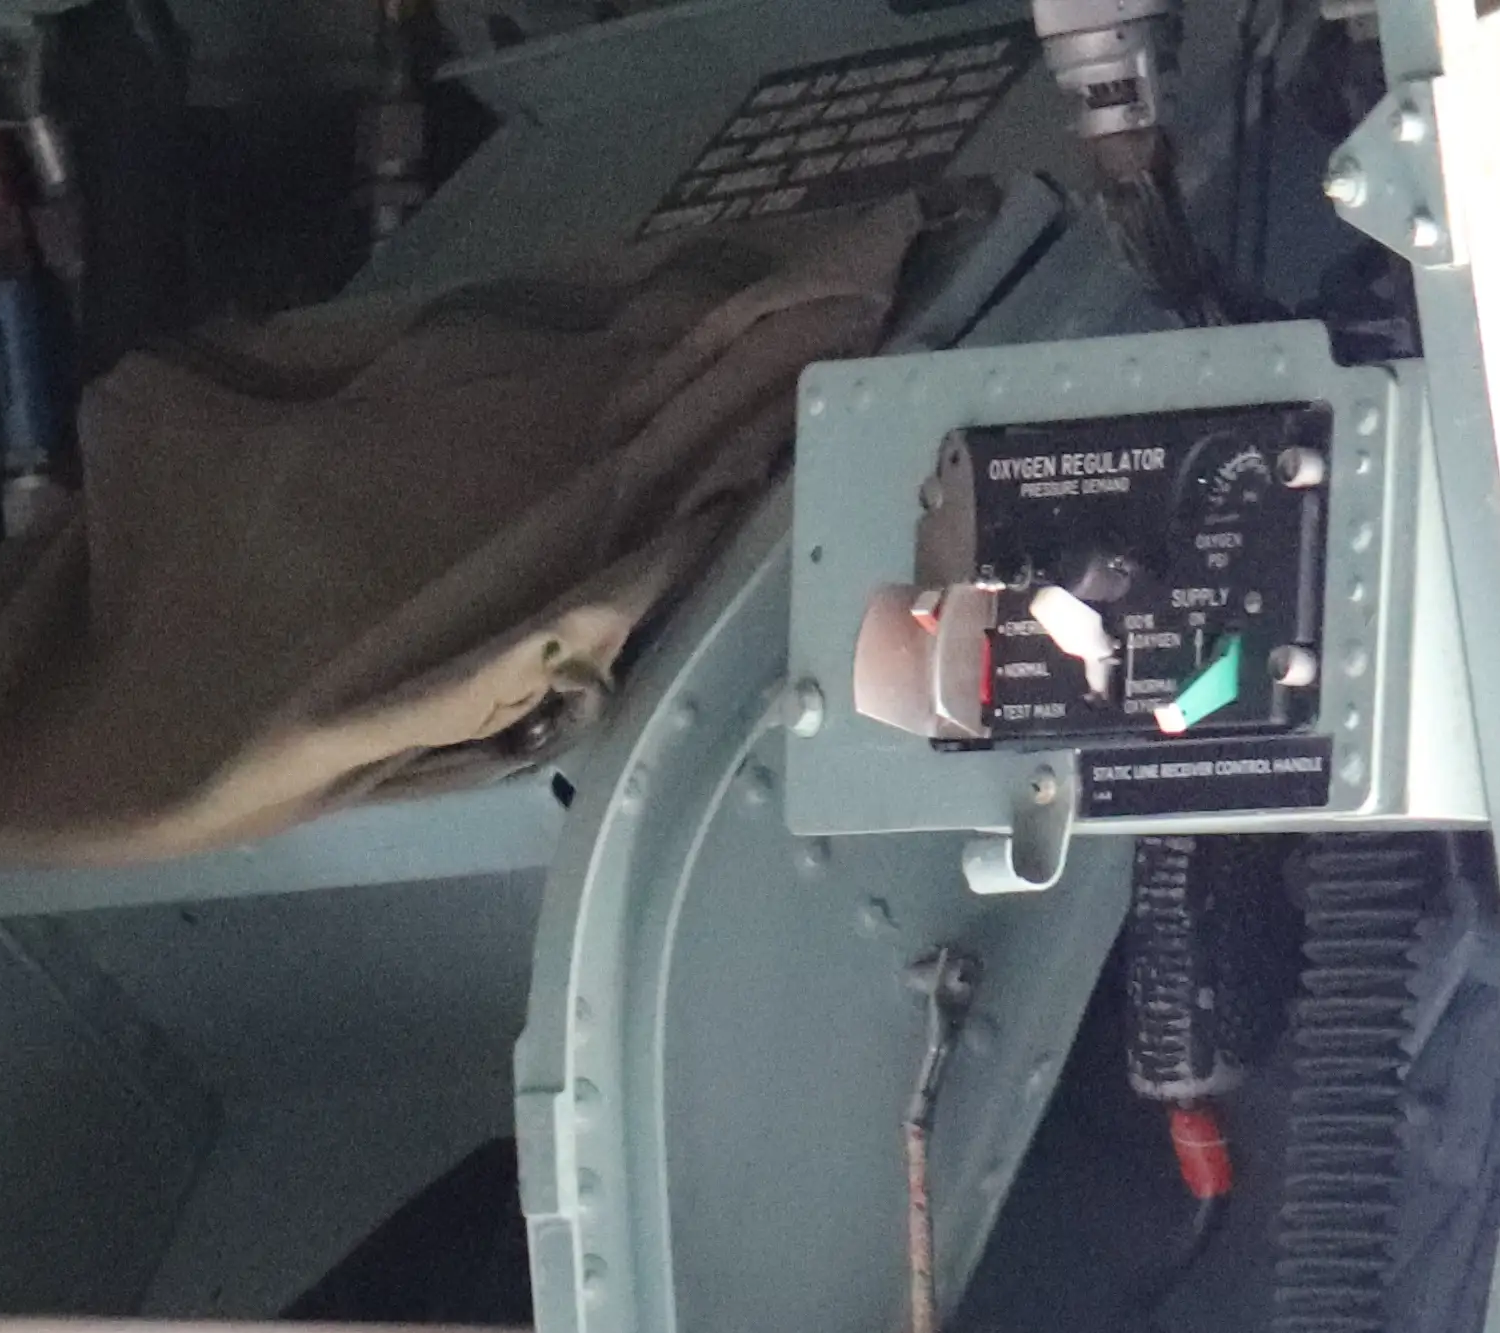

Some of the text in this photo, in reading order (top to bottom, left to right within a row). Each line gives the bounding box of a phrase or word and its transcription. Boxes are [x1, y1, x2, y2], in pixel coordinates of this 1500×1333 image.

[989, 447, 1164, 480] OXYGEN REGULATOR
[1020, 477, 1130, 497] PRESSURE DEMAND
[1171, 587, 1230, 607] SUPPLY
[1003, 662, 1051, 678] NORMAL
[1003, 703, 1031, 720] TEST
[1215, 759, 1272, 775] CONTROL
